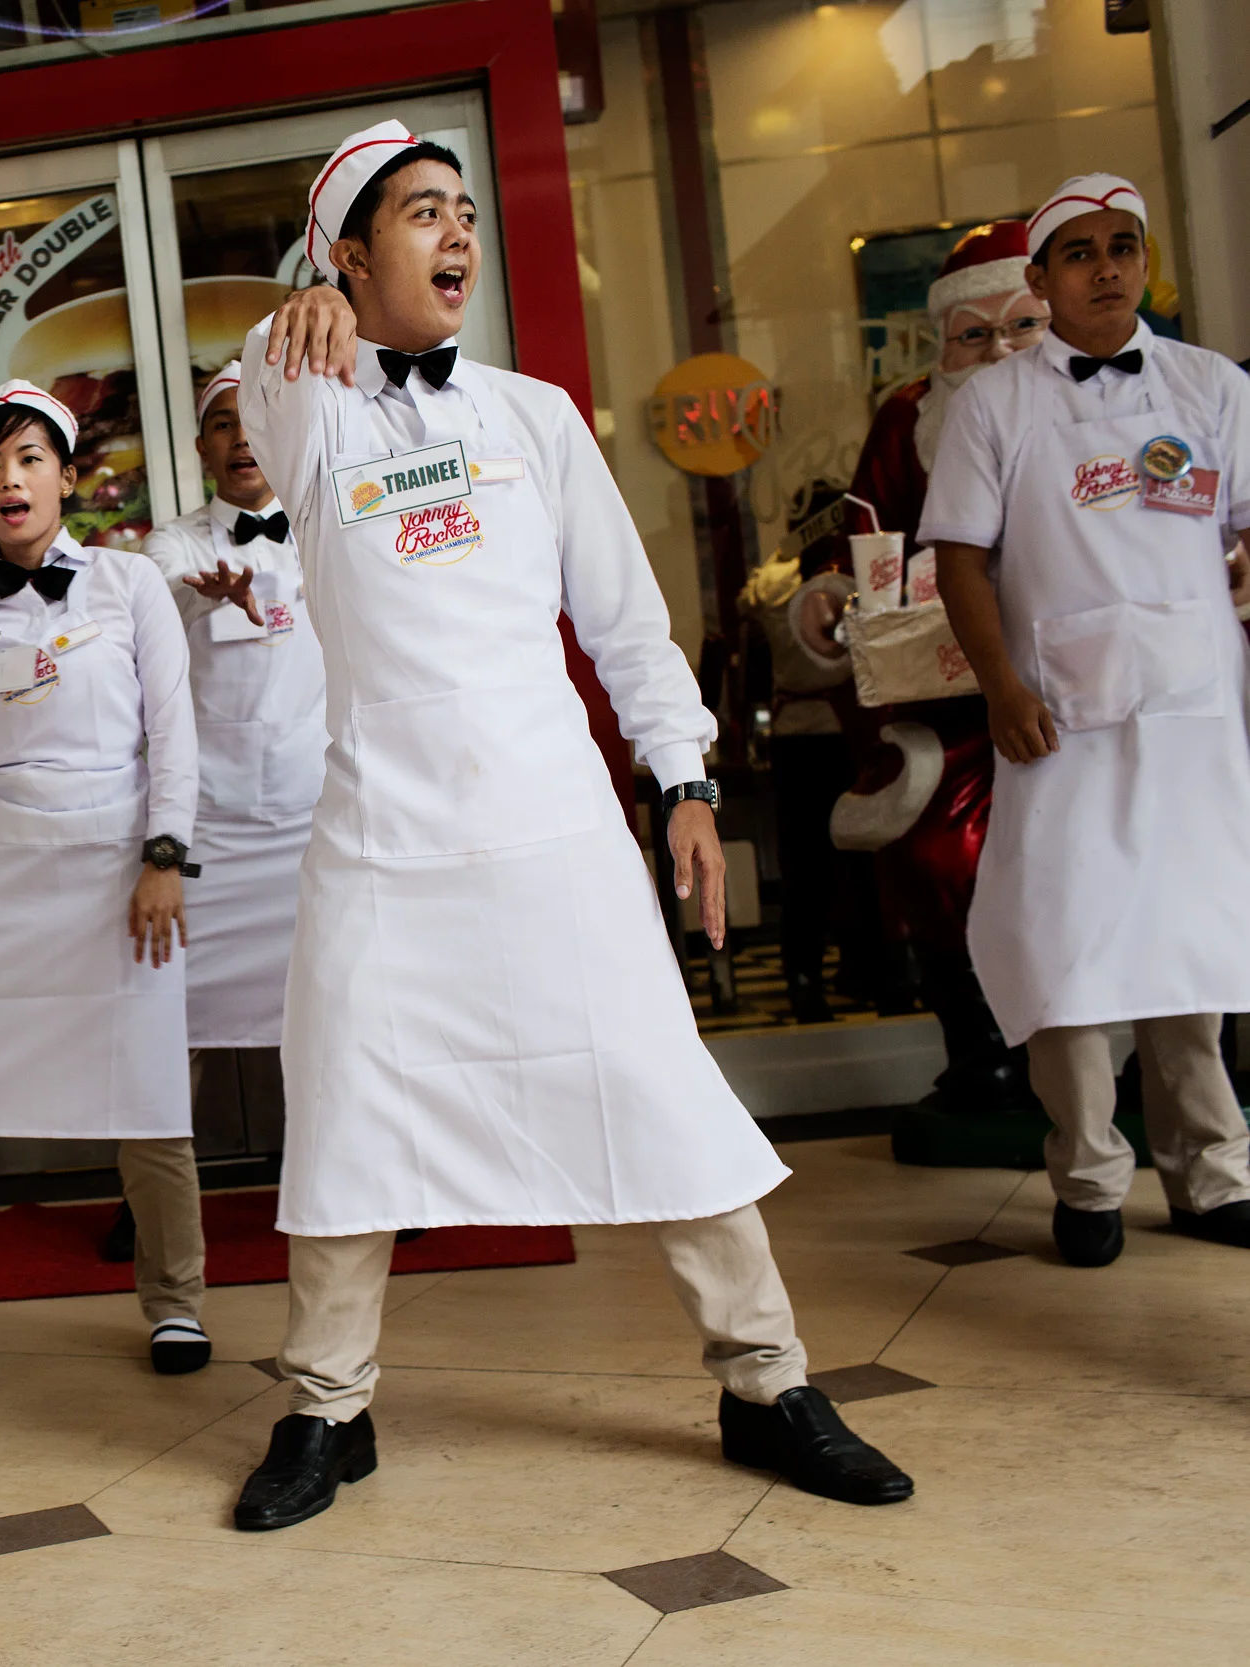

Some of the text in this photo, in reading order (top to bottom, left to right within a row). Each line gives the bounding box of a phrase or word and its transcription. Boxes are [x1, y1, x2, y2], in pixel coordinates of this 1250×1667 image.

[13, 198, 114, 287] DOUBLE
[382, 458, 461, 495] TRAINEE
[395, 500, 470, 553] Johnny
[406, 516, 480, 554] Rockets
[403, 535, 482, 563] THE ORIGINAL HAMBURGER
